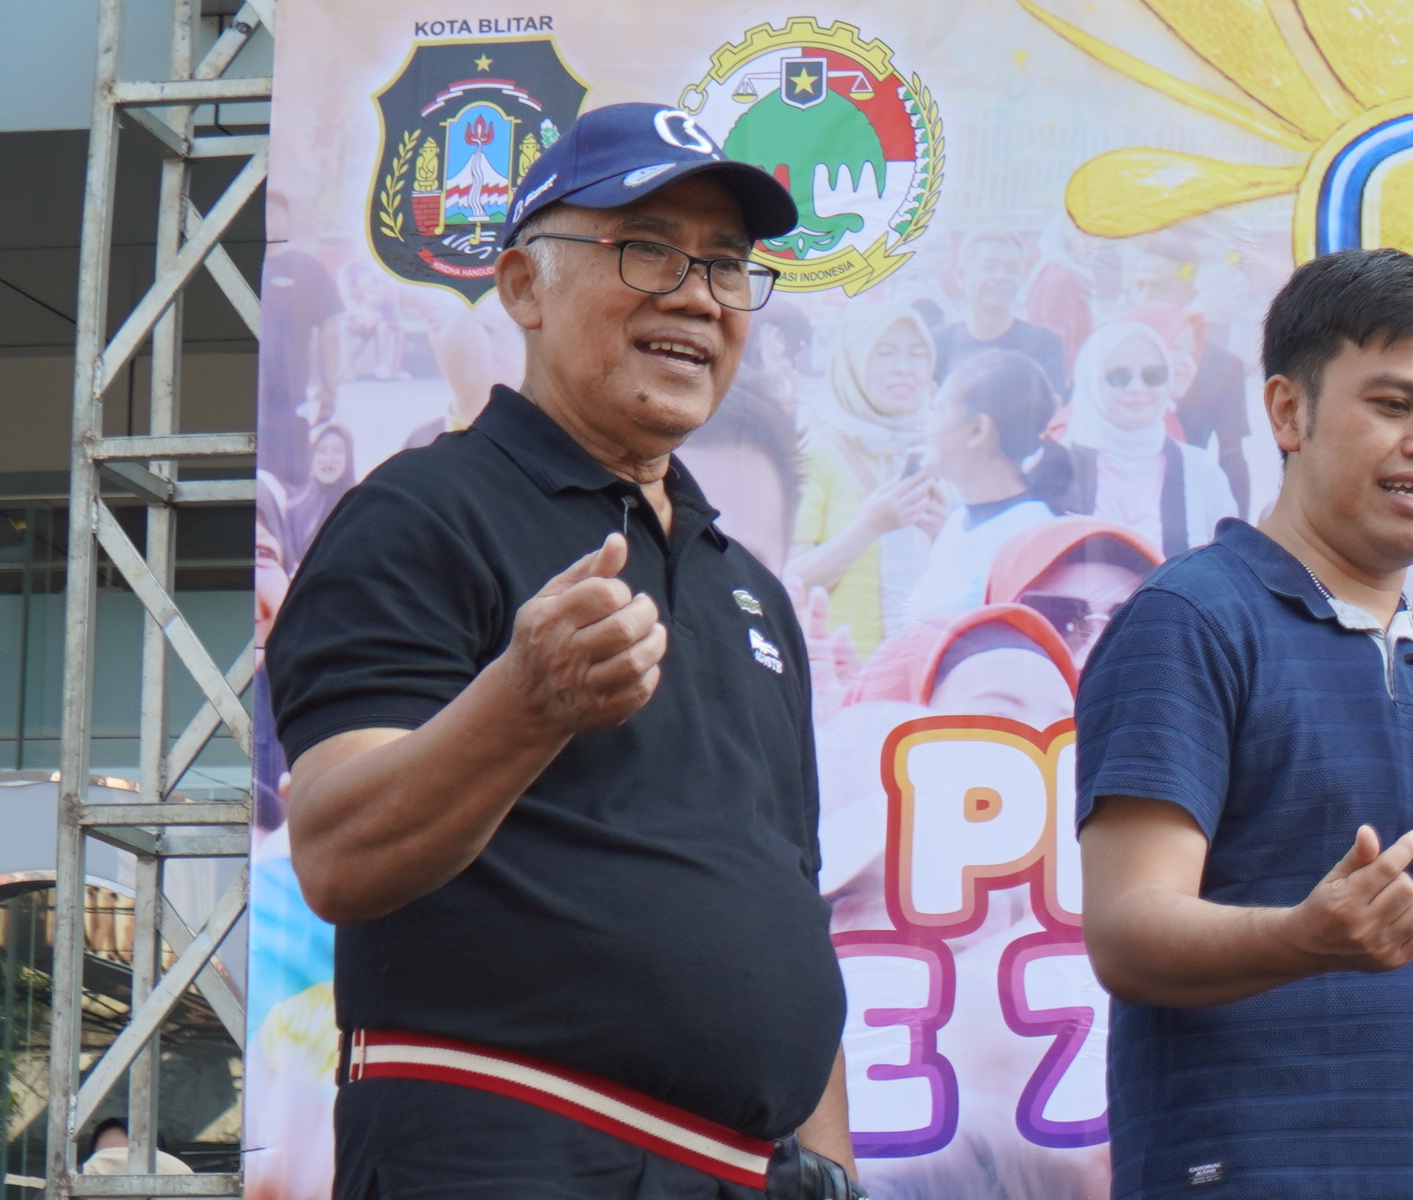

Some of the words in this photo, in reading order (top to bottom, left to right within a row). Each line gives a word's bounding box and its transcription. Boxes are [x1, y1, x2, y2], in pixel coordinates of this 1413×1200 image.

[414, 19, 472, 36] KOTA
[478, 15, 554, 34] BLITAR
[800, 260, 855, 282] INDONESIA
